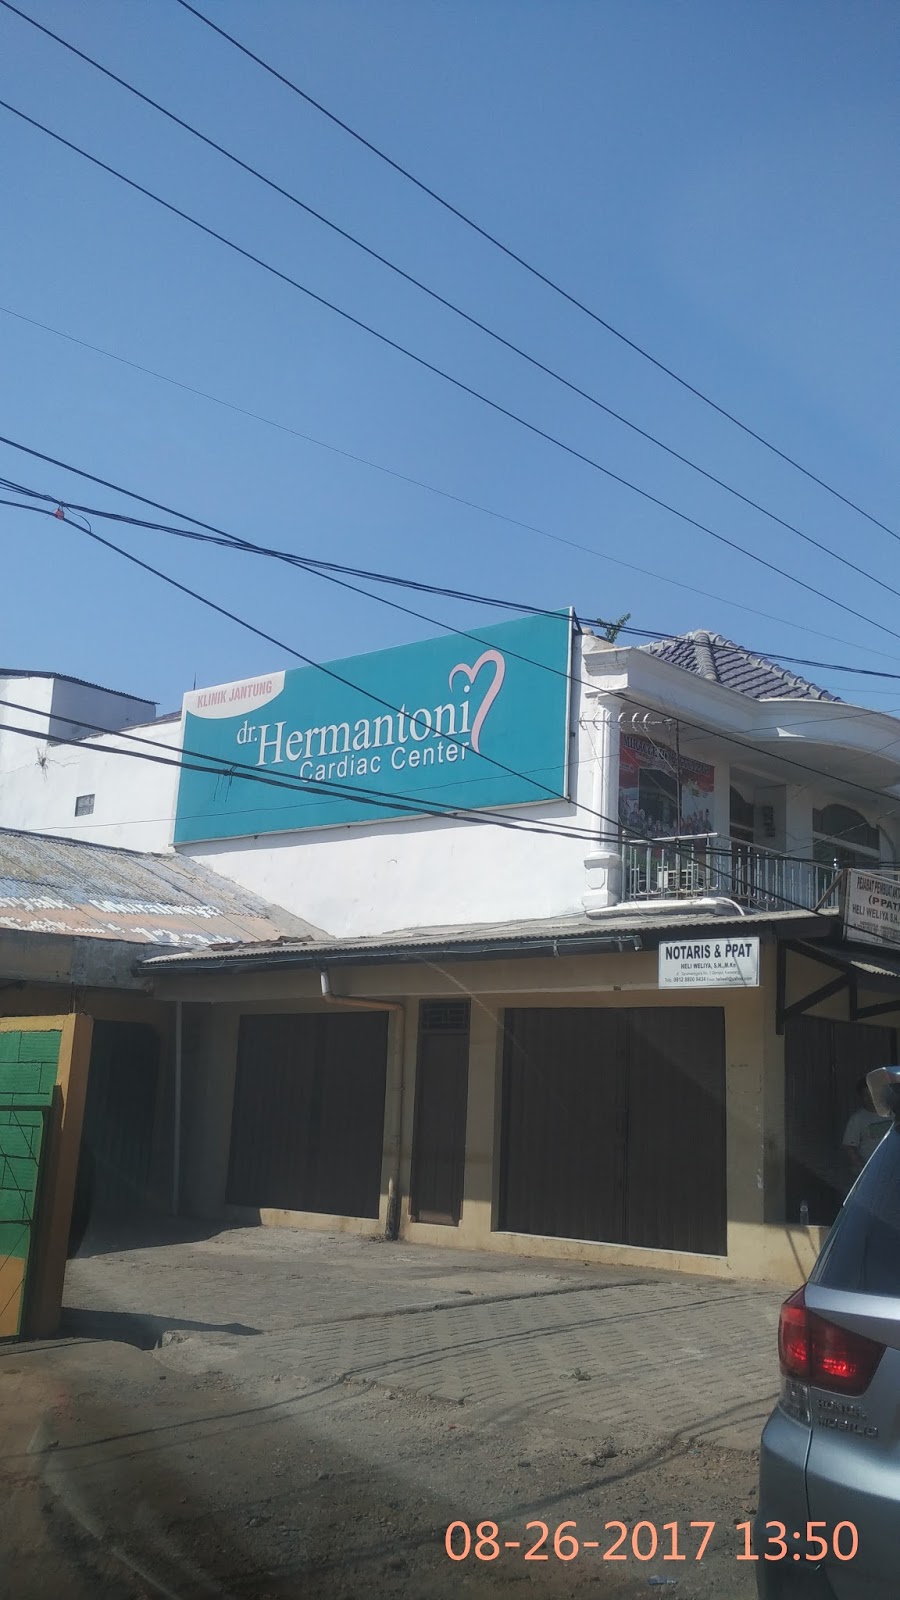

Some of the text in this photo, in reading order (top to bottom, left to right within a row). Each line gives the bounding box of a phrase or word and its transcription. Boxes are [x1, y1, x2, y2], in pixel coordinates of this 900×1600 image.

[197, 680, 272, 708] KLINIK JANTUNG
[236, 684, 472, 767] dr. Hermantoni
[300, 741, 470, 783] Cardiac Center
[665, 943, 752, 960] NOTARIS & PPAT
